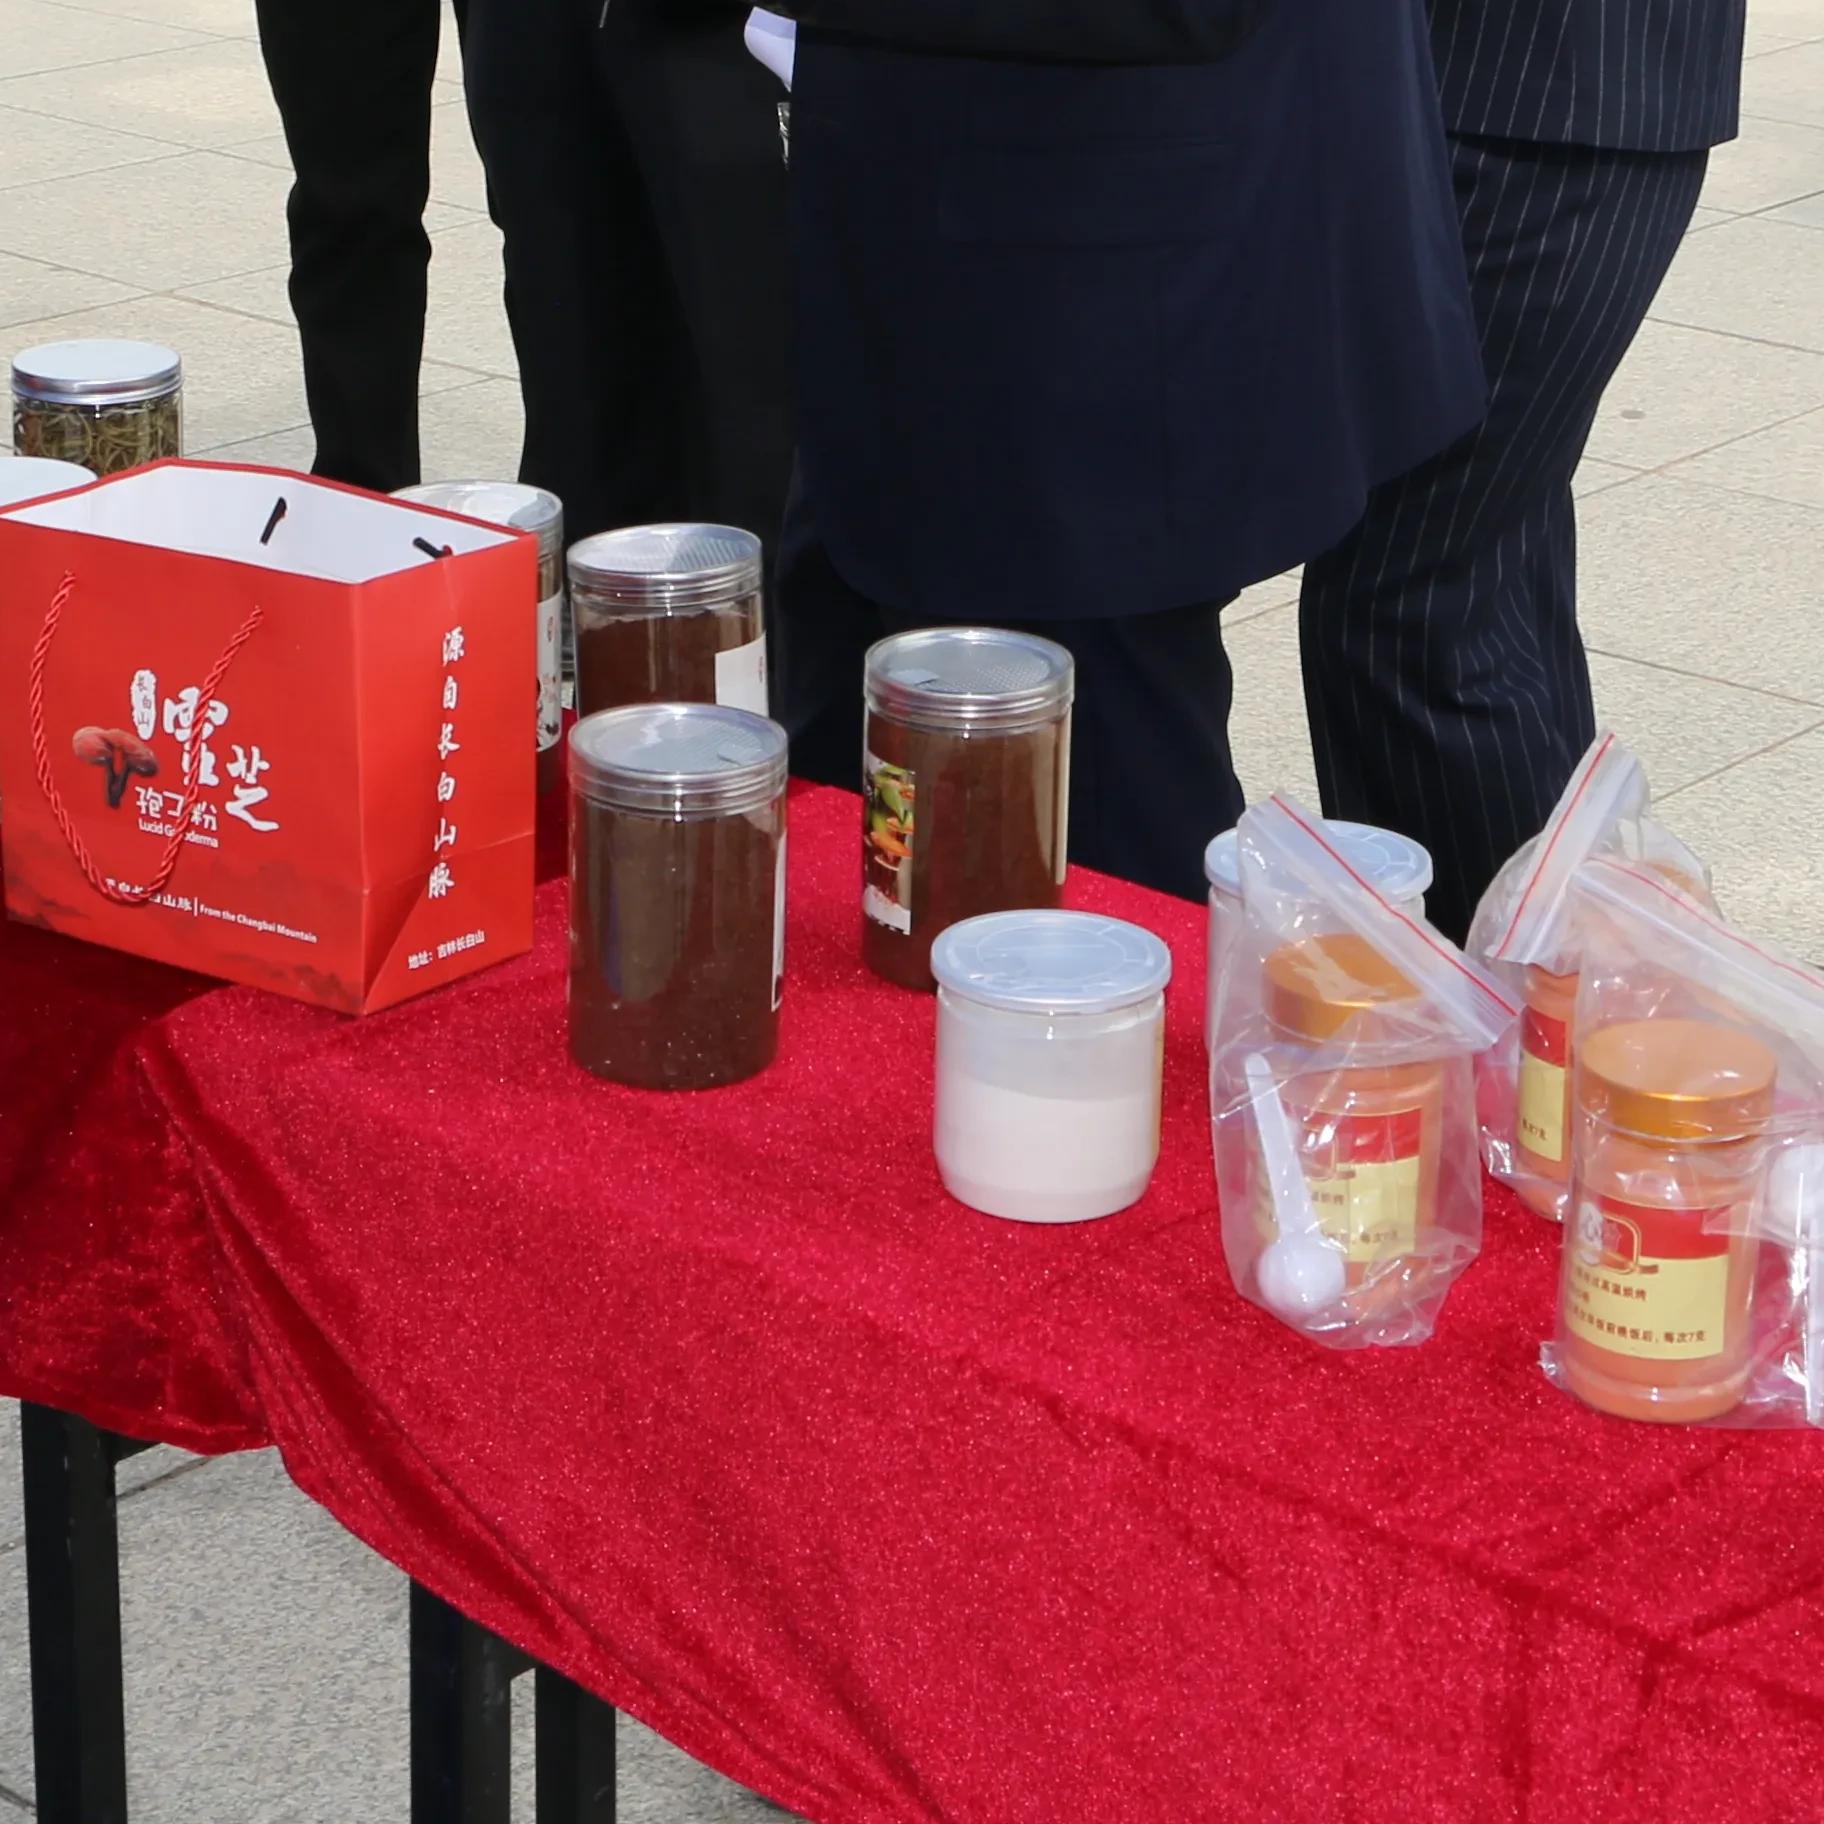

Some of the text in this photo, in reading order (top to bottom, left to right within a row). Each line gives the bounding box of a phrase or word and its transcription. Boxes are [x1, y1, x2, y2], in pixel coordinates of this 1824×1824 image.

[428, 626, 466, 899] 源自长白山脉
[200, 904, 317, 943] From the Changbai Mountain
